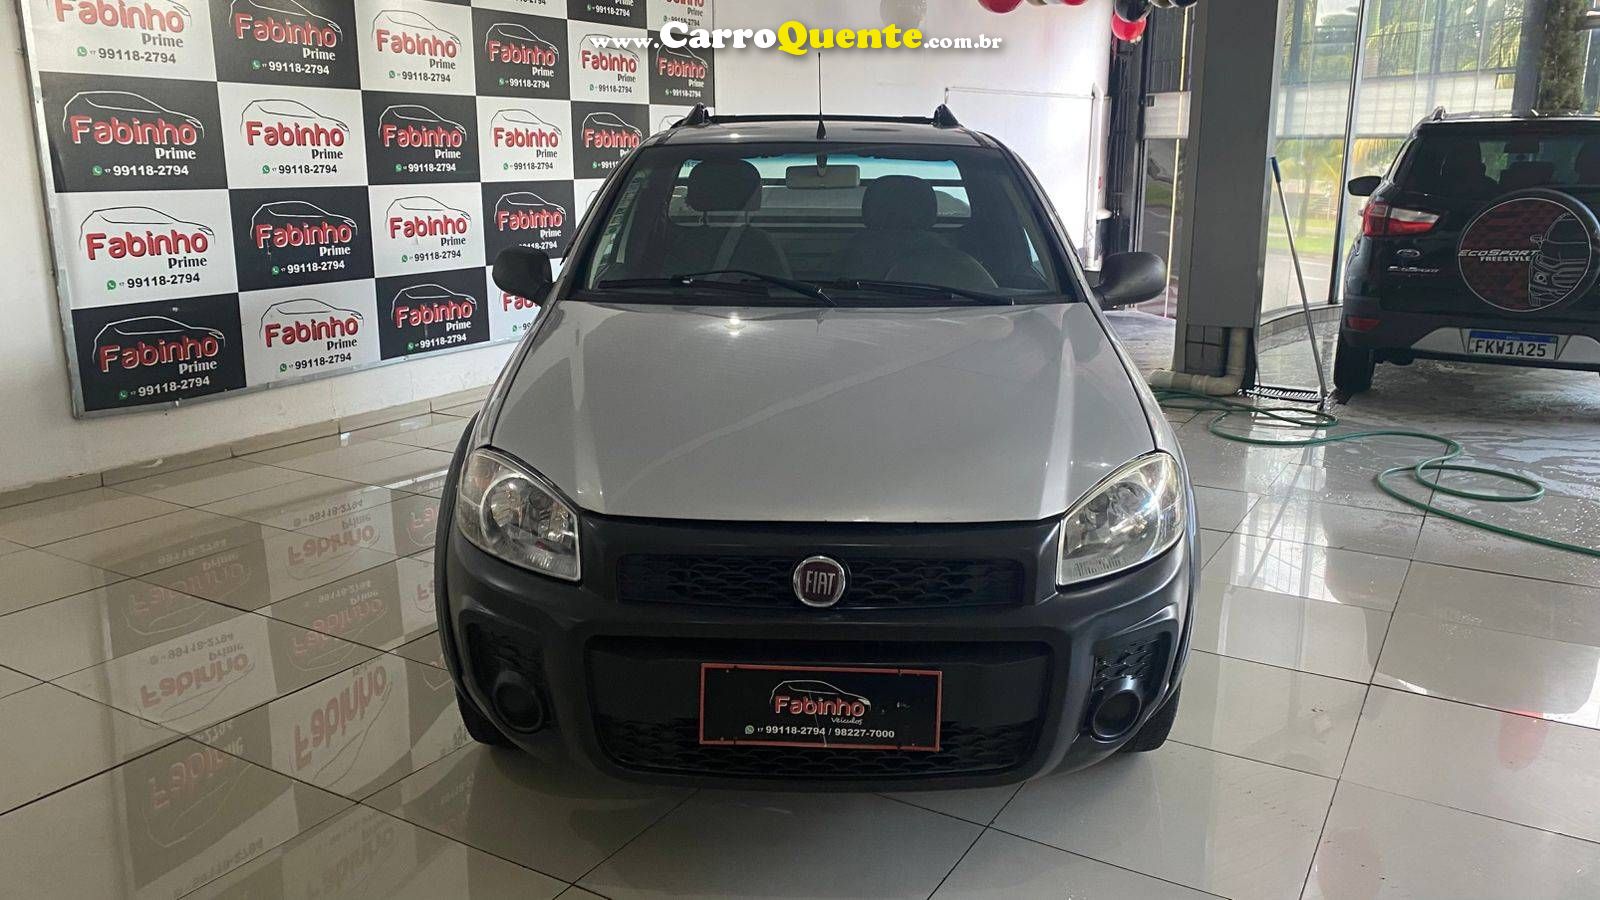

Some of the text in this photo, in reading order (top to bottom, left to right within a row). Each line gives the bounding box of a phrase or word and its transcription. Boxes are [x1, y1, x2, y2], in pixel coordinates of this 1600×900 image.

[55, 0, 184, 33] Fabinho
[235, 12, 337, 48] Fabinho
[141, 33, 184, 48] Prime
[376, 29, 458, 58] Fabinho
[98, 48, 176, 64] 99118-2794
[302, 47, 336, 61] Prime
[488, 40, 556, 67] Fabinho
[581, 49, 637, 73] Fabinho
[268, 61, 330, 75] 99118-2794
[429, 58, 456, 70] Prime
[532, 66, 554, 77] Prime
[659, 57, 706, 79] Fabinho
[401, 71, 451, 83] 99118-2794
[509, 78, 550, 89] 99118-2794
[617, 73, 636, 83] Prime
[598, 83, 633, 94] 99118-2794
[69, 115, 198, 146] Fabinho
[246, 120, 345, 147] Fabinho
[382, 124, 463, 148] Fabinho
[493, 127, 558, 148] Fabinho
[583, 128, 640, 149] Fabinho
[154, 146, 197, 160] Prime
[311, 148, 343, 160] Prime
[434, 149, 461, 159] Prime
[536, 149, 558, 158] Prime
[112, 165, 189, 176] 99118-2794
[278, 164, 338, 174] 99118-2794
[407, 163, 456, 172] 99118-2794
[513, 161, 553, 170] 99118-2794
[389, 215, 468, 239] Fabinho
[497, 209, 563, 231] Fabinho
[255, 221, 352, 249] Fabinho
[540, 228, 562, 239] Prime
[86, 229, 208, 261] Fabinho
[440, 237, 466, 247] Prime
[319, 245, 351, 257] Prime
[414, 250, 461, 262] 99118-2794
[168, 256, 208, 269] Prime
[287, 260, 345, 274] 99118-2794
[127, 272, 201, 289] 99118-2794
[395, 300, 473, 329] Fabinho
[264, 316, 359, 348] Fabinho
[445, 320, 472, 332] Prime
[327, 338, 358, 351] Prime
[419, 333, 467, 349] 99118-2794
[1475, 339, 1547, 357] FKW1A25
[99, 335, 219, 373] Fabinho
[294, 352, 352, 370] 99118-2794
[178, 359, 218, 375] Prime
[138, 375, 210, 397] 99118-2794
[805, 570, 836, 596] FIAT
[774, 695, 865, 718] Fabinho
[765, 725, 826, 736] 99118-2794
[834, 728, 895, 738] 98227-7000
